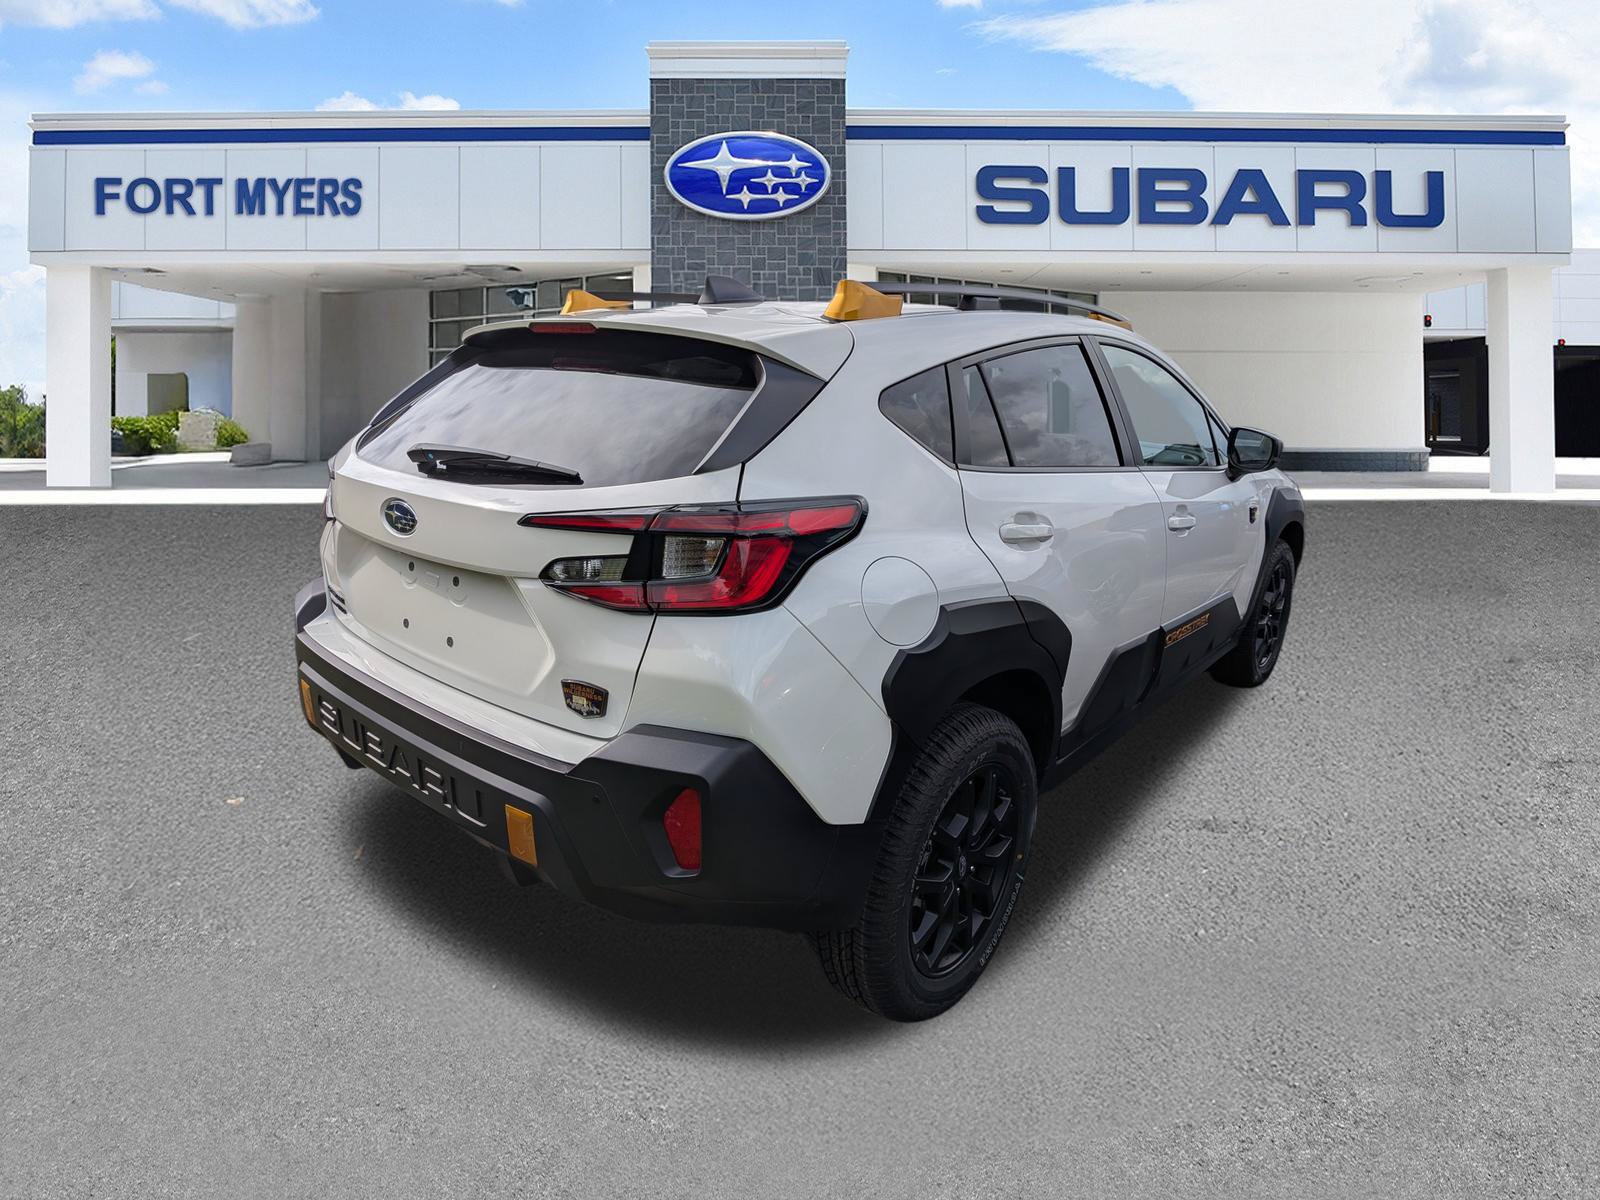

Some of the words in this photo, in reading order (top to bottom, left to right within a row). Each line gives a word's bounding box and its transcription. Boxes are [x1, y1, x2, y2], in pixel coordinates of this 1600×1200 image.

[95, 177, 222, 216] FORT
[235, 177, 362, 216] MYERS
[975, 165, 1446, 228] SUBARU
[318, 694, 488, 828] SUBARU
